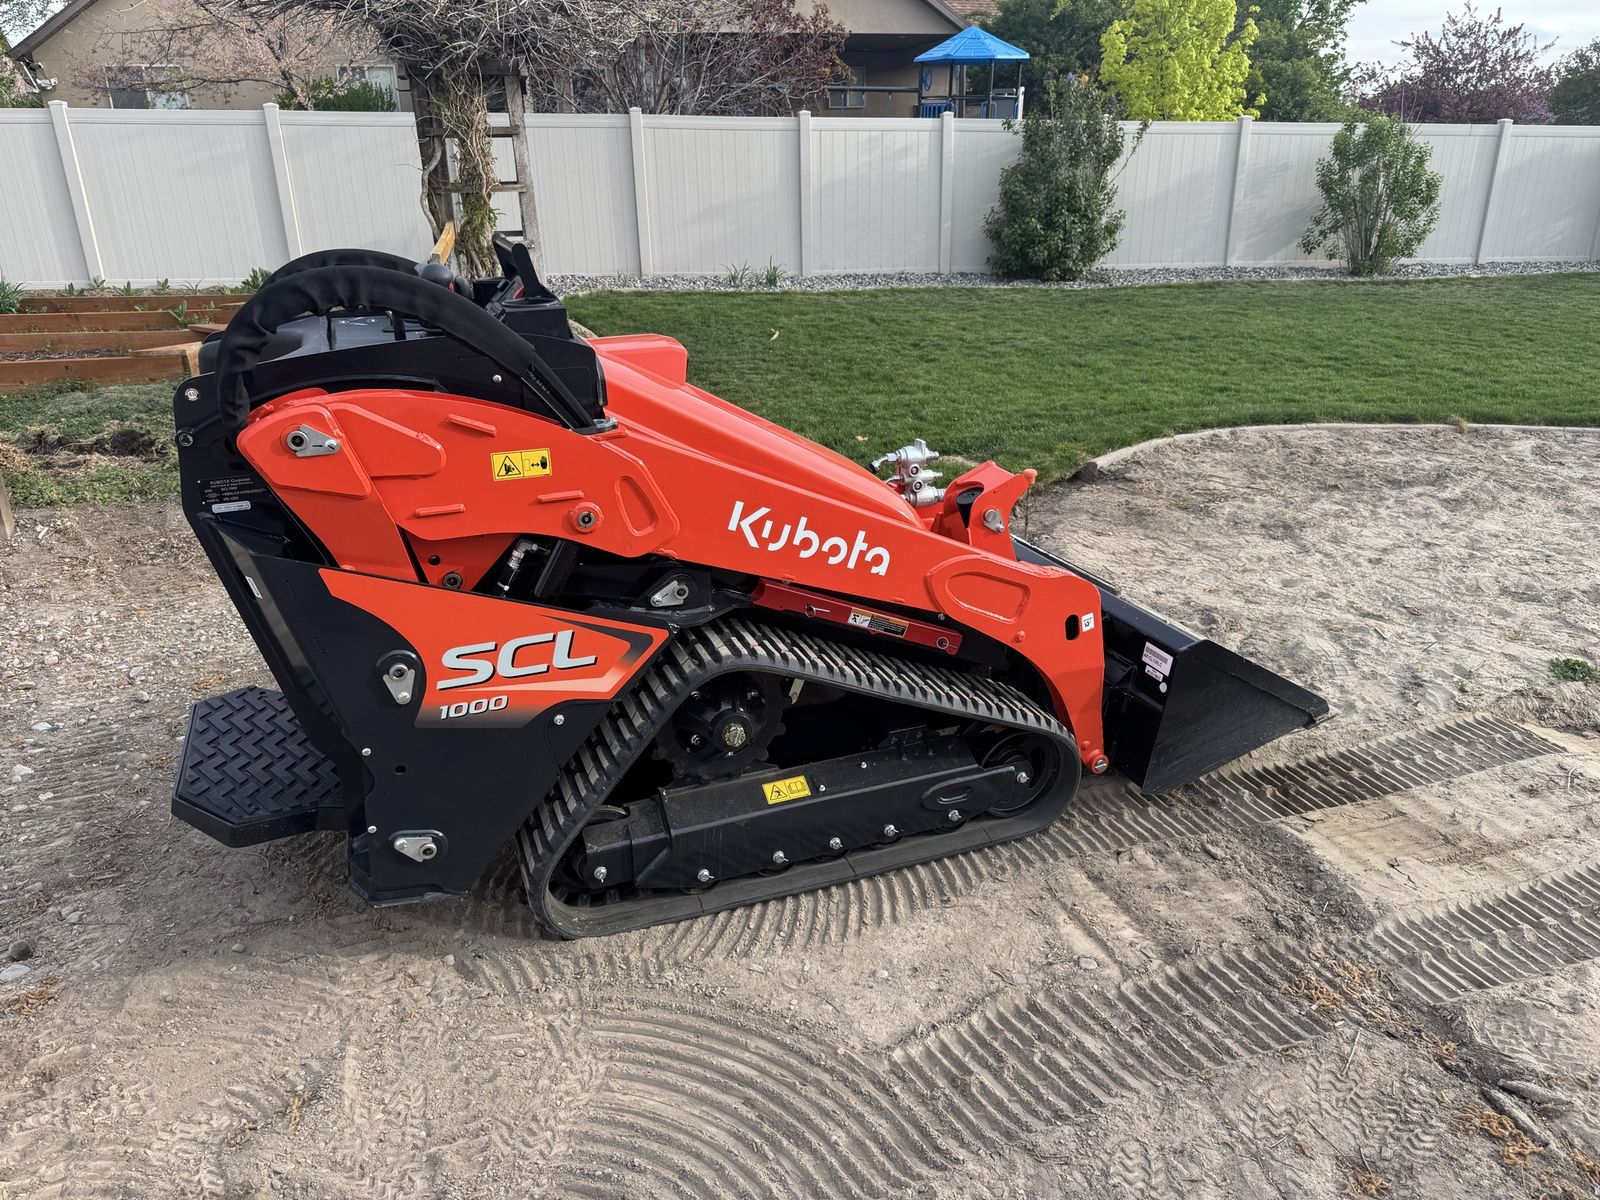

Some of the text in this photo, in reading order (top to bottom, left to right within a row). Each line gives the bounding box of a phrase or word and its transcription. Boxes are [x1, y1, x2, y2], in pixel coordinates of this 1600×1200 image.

[727, 500, 890, 576] Kubota
[437, 629, 597, 690] SCL
[439, 695, 509, 720] 1000
